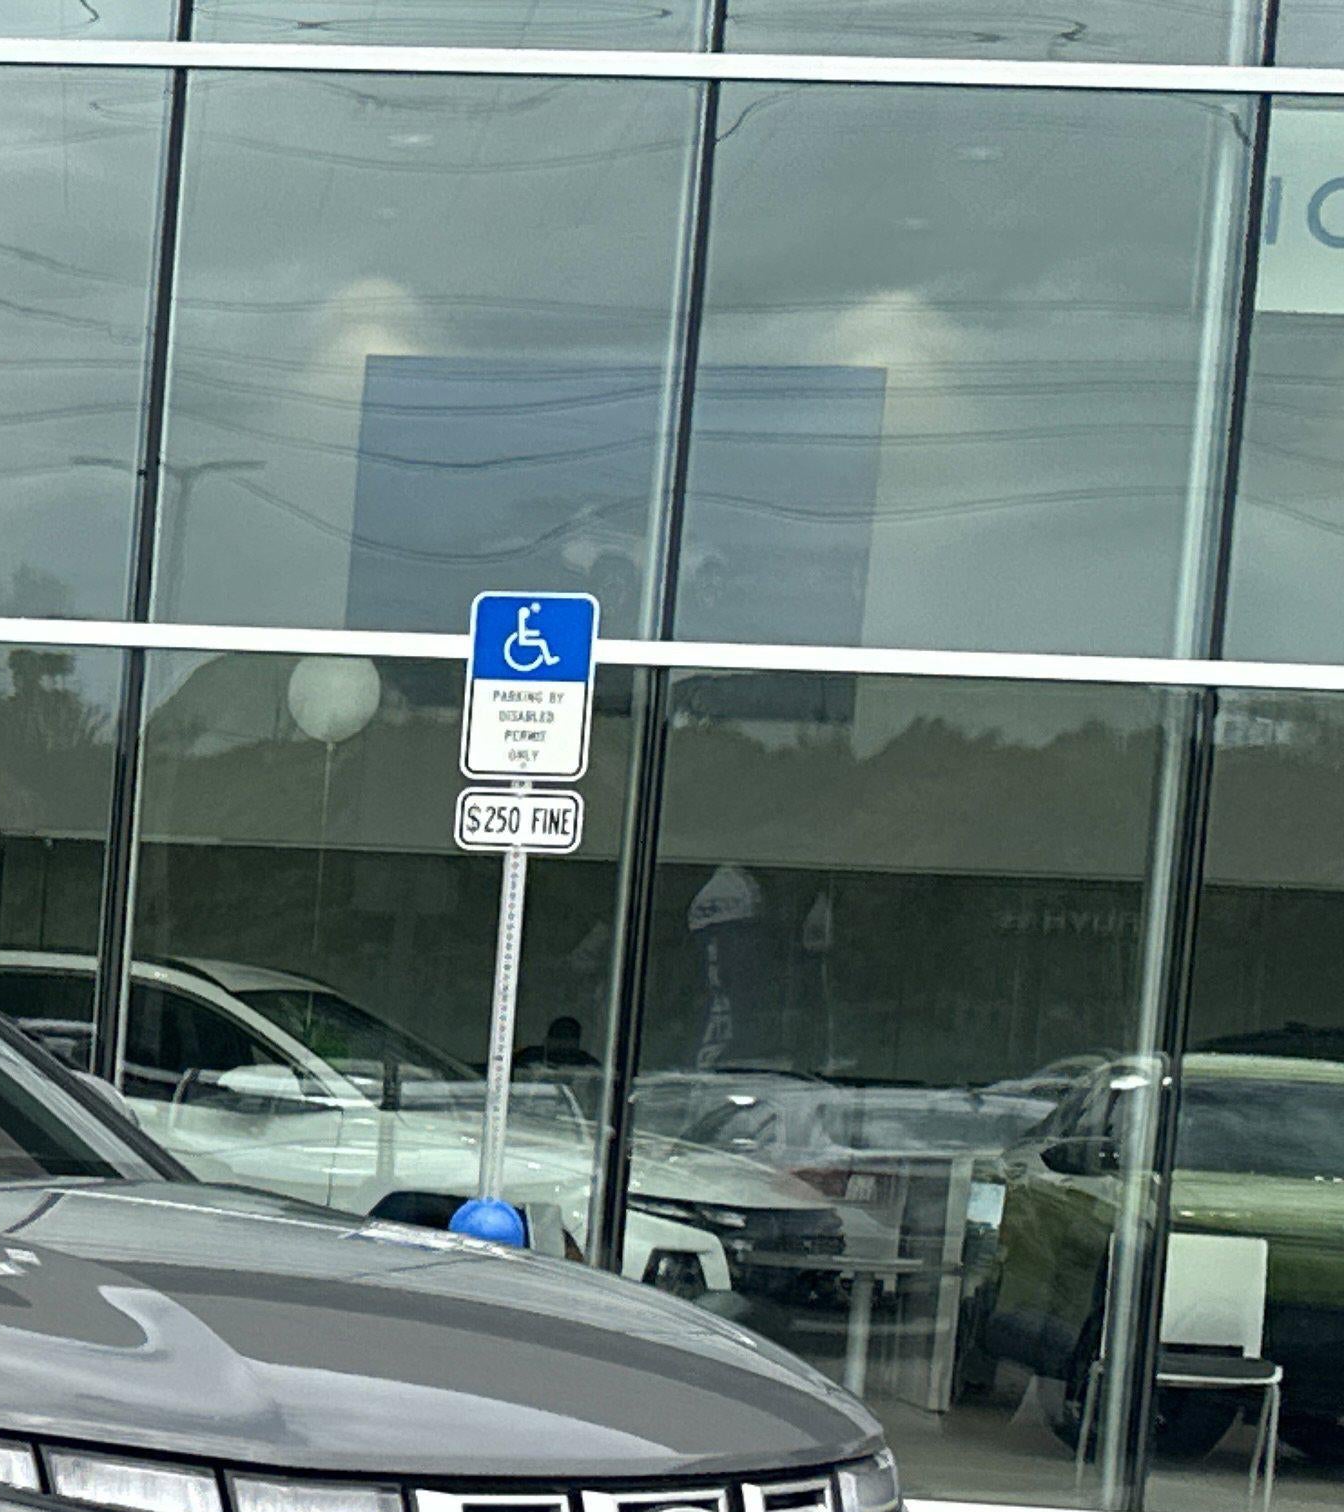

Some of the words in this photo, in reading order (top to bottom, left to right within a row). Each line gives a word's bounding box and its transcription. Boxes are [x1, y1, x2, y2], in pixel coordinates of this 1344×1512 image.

[493, 690, 543, 704] PARKING
[549, 692, 564, 704] BY
[498, 710, 555, 723] DISABLED
[504, 730, 547, 742] PERMIT
[508, 749, 540, 762] ONLY
[467, 804, 520, 834] $250
[531, 808, 572, 835] FINE
